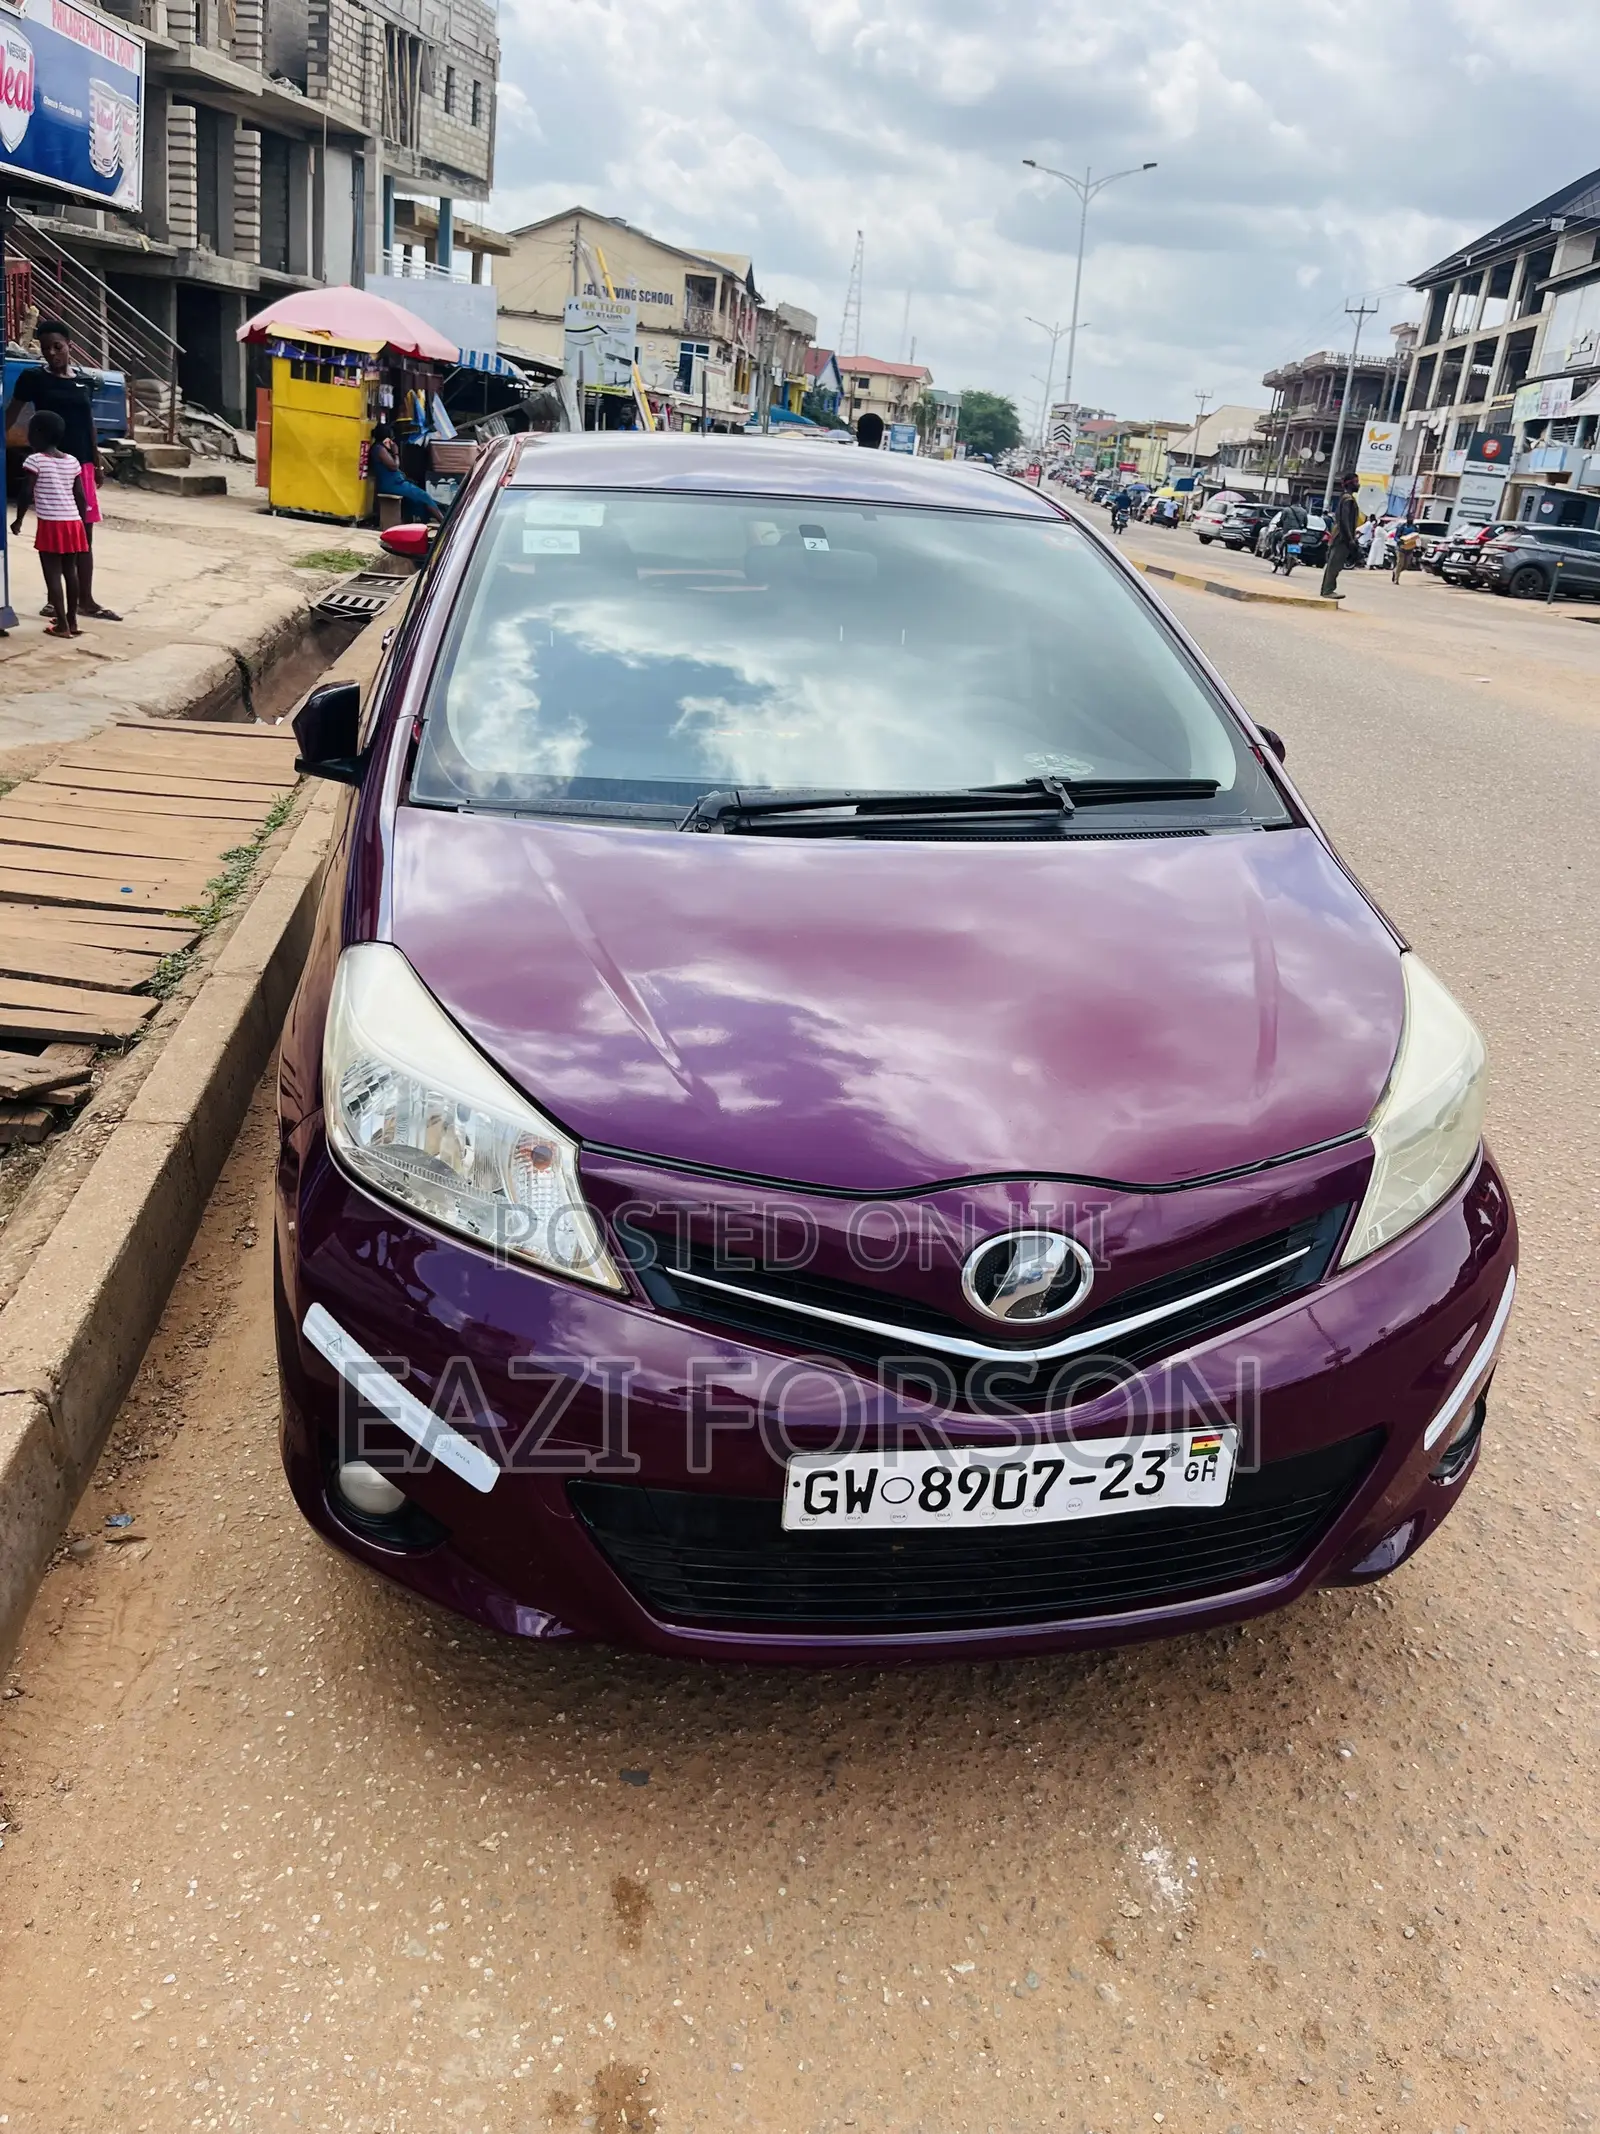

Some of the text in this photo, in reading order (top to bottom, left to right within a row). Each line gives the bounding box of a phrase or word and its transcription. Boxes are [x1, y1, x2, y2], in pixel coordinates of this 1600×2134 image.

[0, 45, 34, 113] eal
[639, 290, 674, 306] SCHOOL
[1370, 442, 1393, 452] GCB
[804, 1448, 1169, 1515] GW 8907-23
[1184, 1459, 1217, 1482] GH
